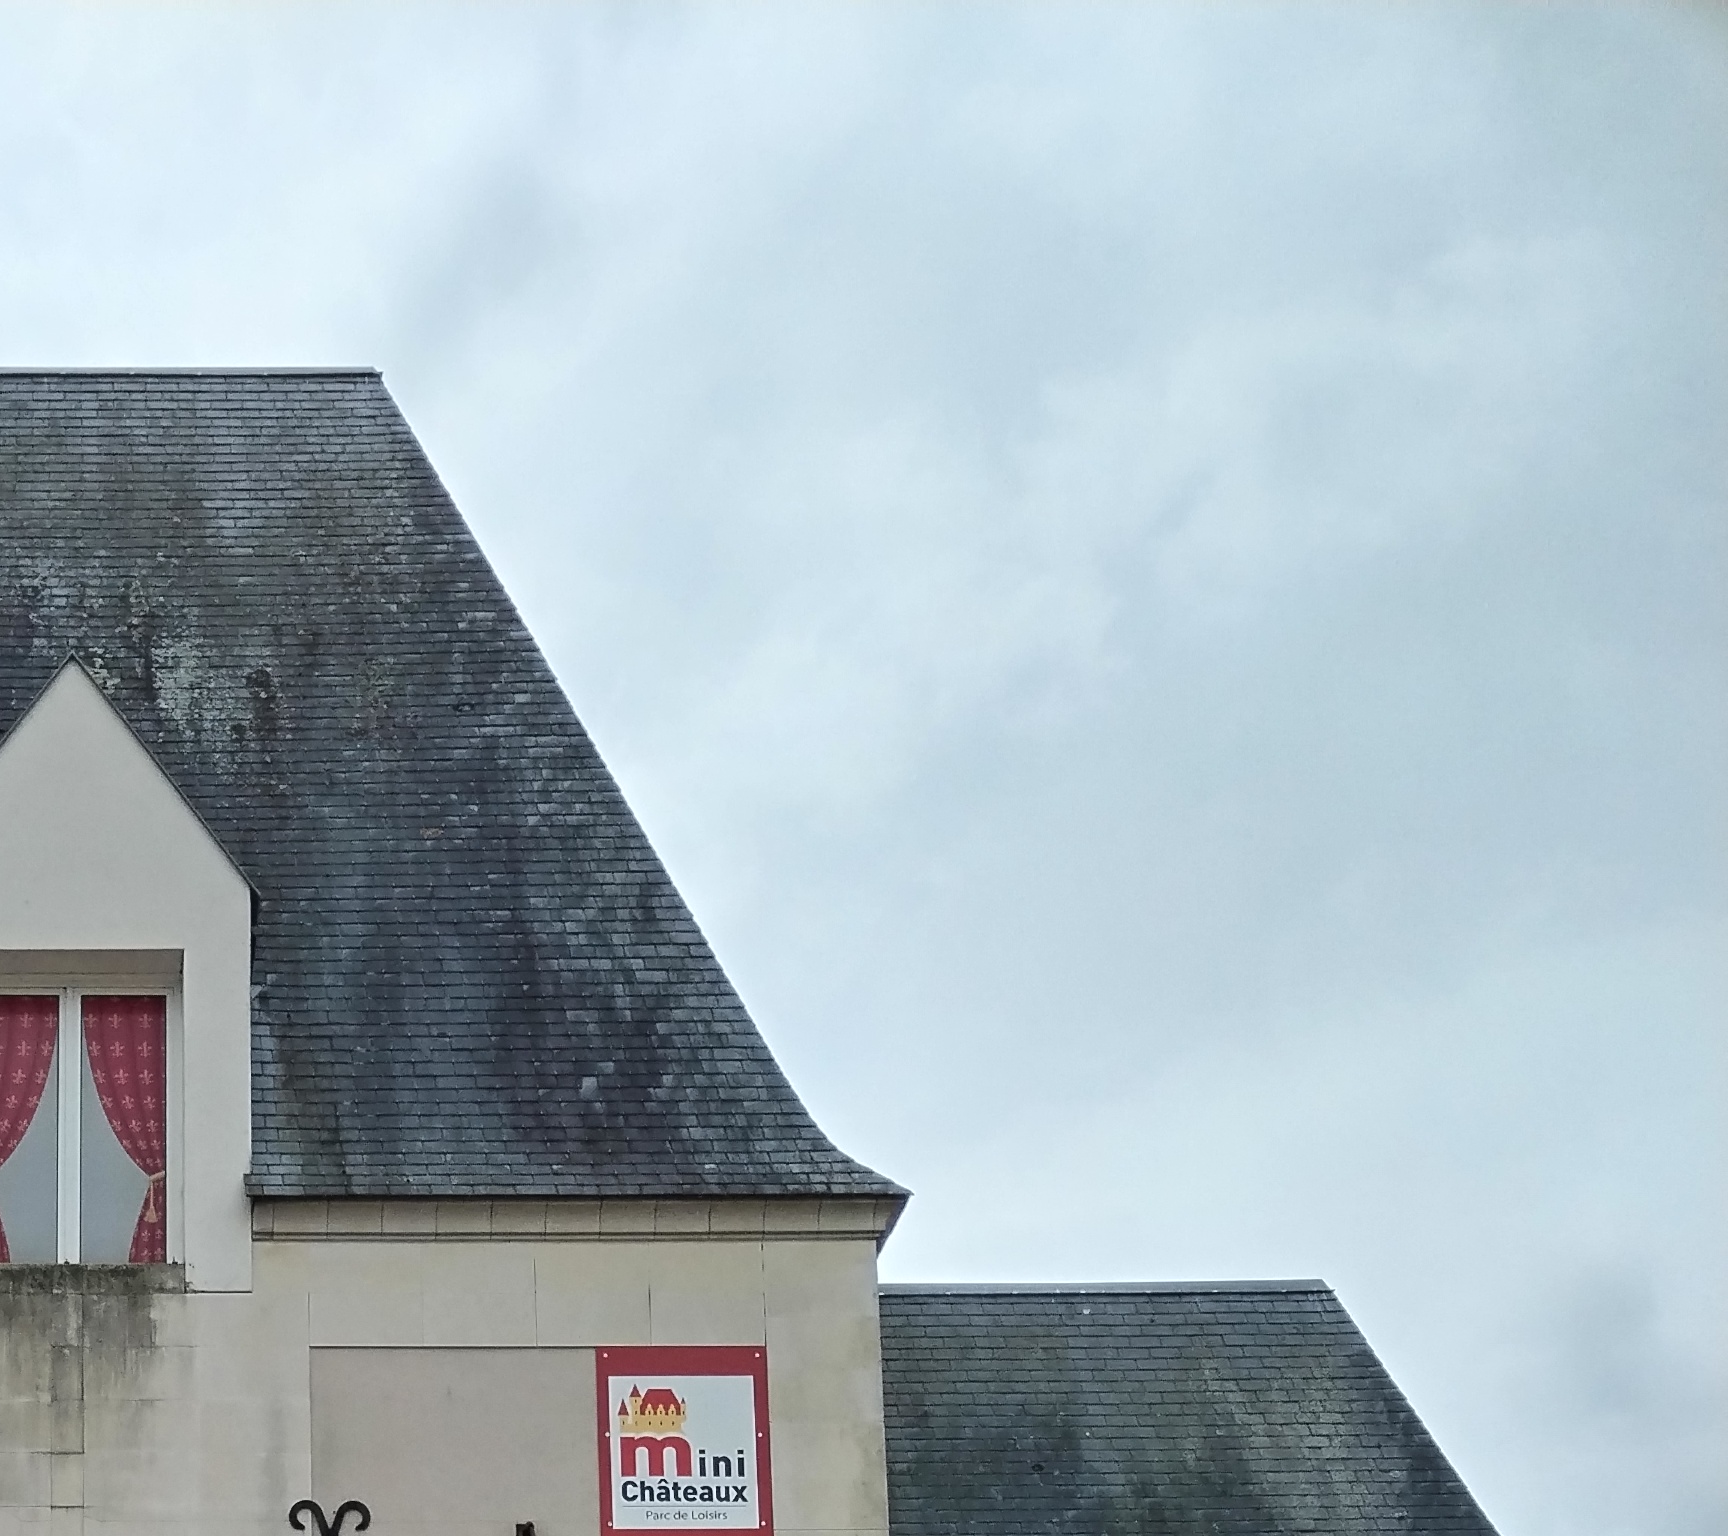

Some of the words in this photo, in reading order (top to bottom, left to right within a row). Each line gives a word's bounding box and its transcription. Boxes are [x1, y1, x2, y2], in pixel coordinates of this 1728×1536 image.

[620, 1437, 745, 1477] mini
[621, 1478, 749, 1503] Châteaux
[645, 1510, 671, 1520] Parc
[673, 1510, 688, 1521] de
[691, 1510, 728, 1521] Loisirs
